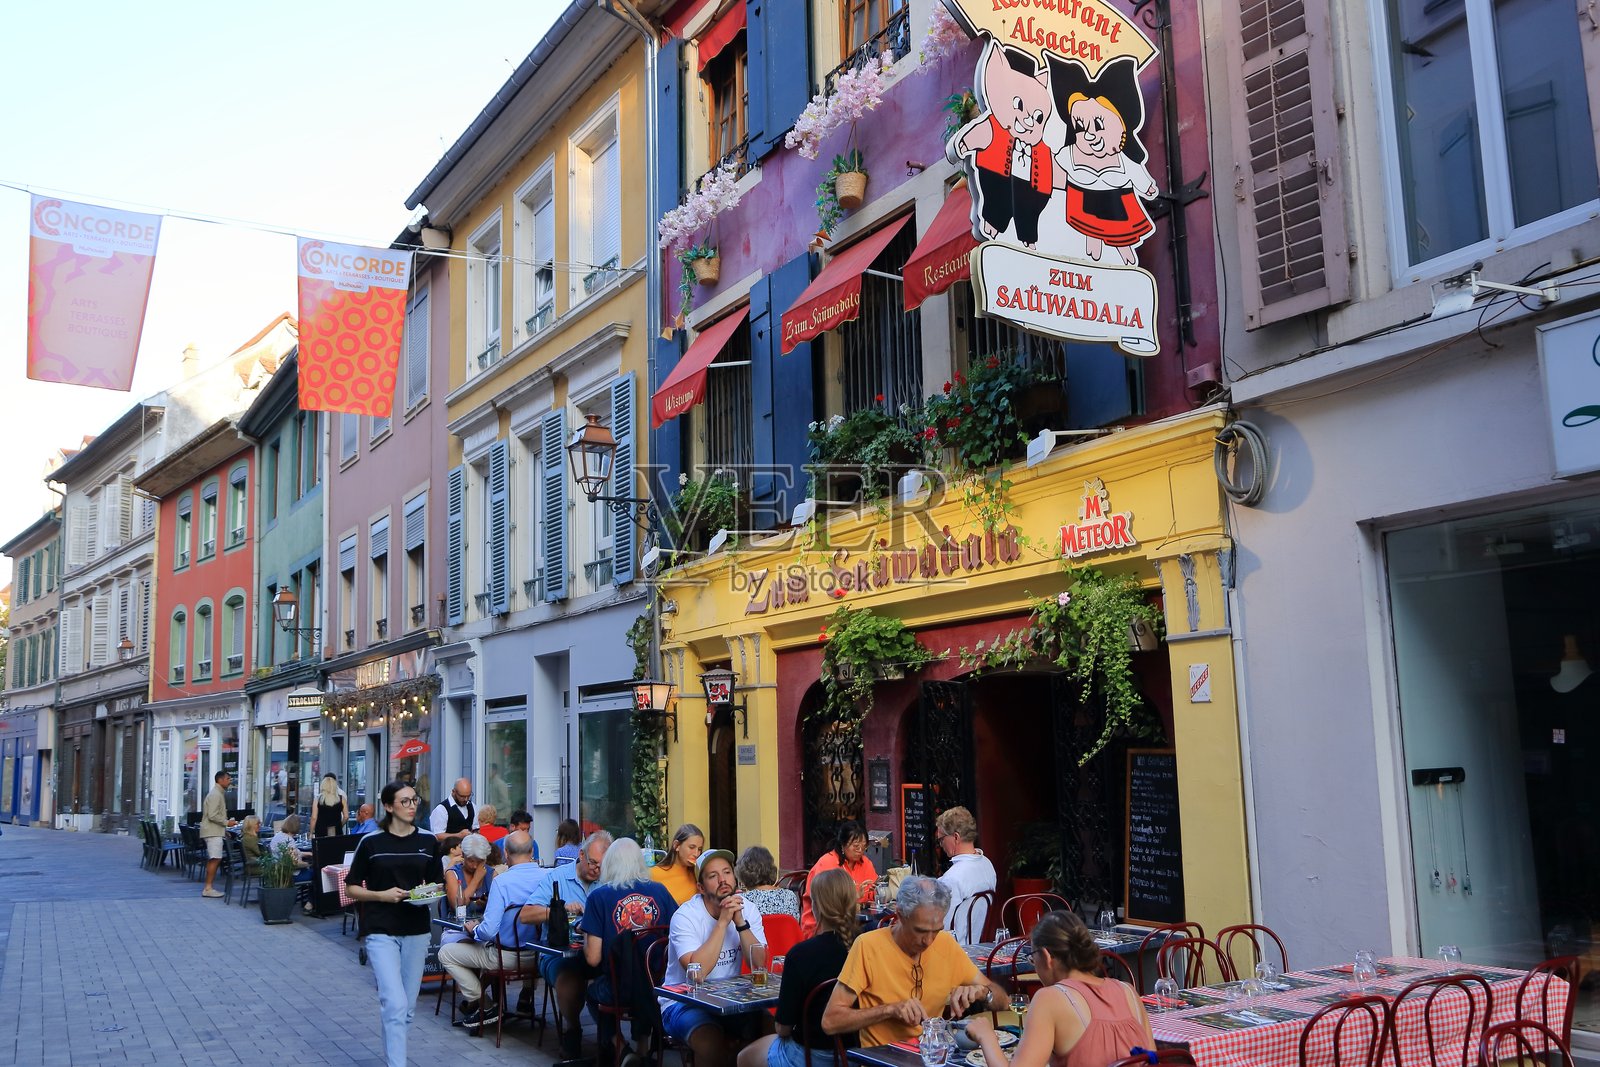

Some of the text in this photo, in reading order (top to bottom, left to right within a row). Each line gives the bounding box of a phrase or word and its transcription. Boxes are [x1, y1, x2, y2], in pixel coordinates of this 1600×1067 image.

[1009, 15, 1103, 62] Alsacien
[34, 199, 156, 242] CONCORDE
[301, 241, 407, 277] CONCORDE
[1049, 268, 1093, 292] ZUM
[69, 310, 127, 326] TERRASSES
[70, 297, 98, 309] ARTS
[995, 284, 1145, 330] SAÜWADALA
[67, 323, 129, 340] BOUTIQUES
[785, 319, 808, 341] Zum
[1060, 514, 1131, 555] METEOR
